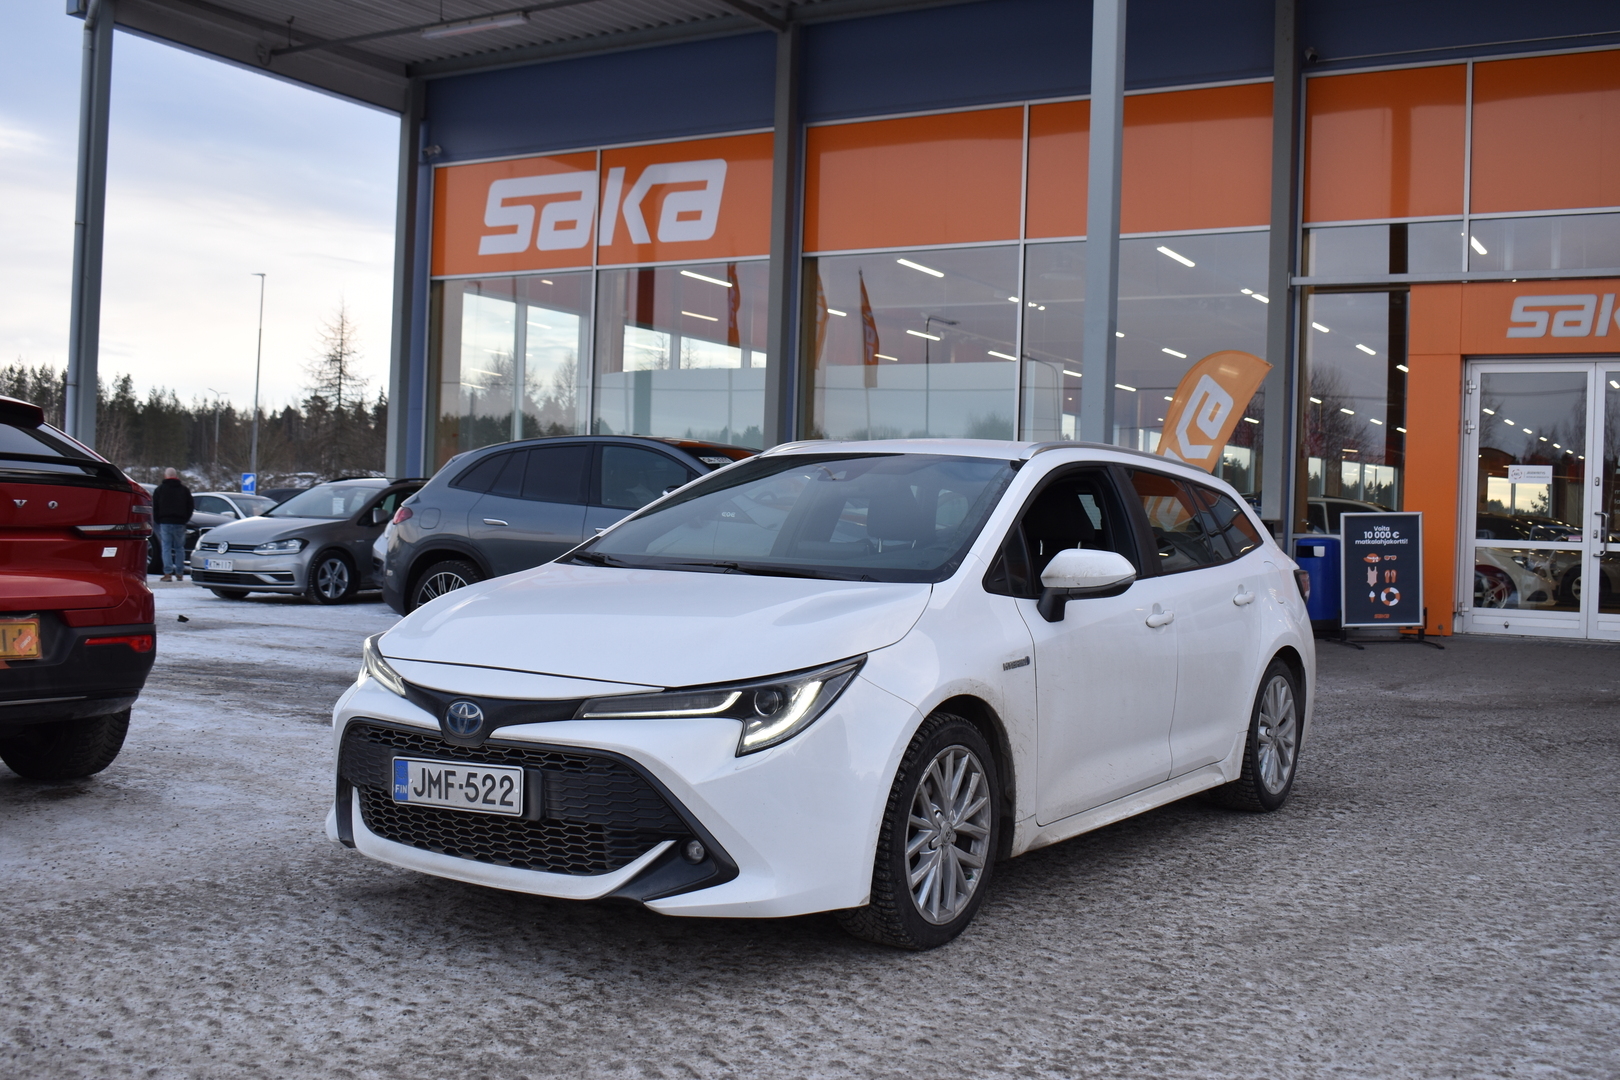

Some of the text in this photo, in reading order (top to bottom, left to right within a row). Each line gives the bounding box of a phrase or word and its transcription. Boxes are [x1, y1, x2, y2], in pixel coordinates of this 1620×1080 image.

[1355, 538, 1408, 546] matkalahjakortti!
[395, 784, 408, 794] FIN
[413, 768, 514, 807] JMF-522
